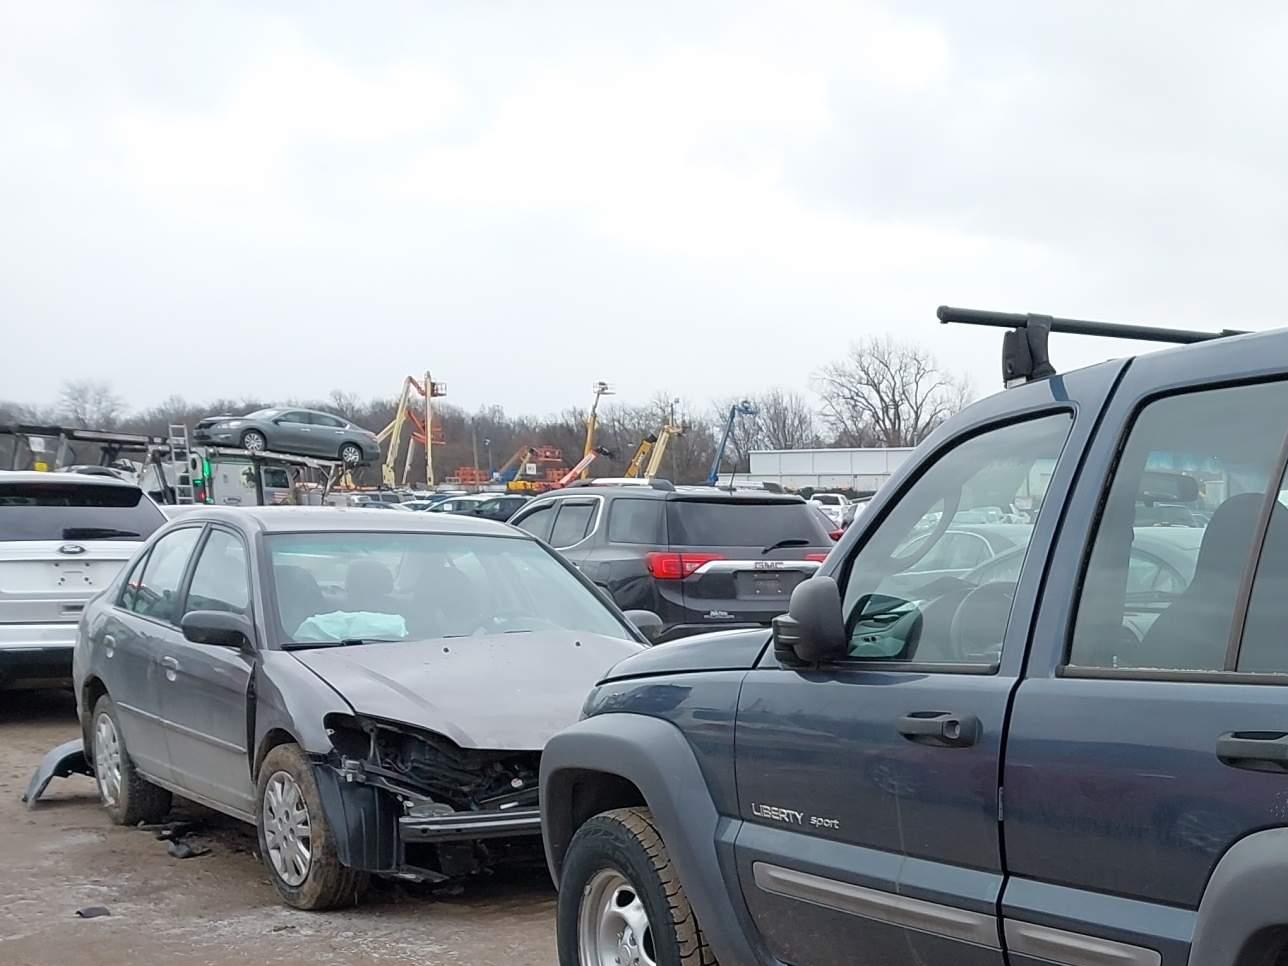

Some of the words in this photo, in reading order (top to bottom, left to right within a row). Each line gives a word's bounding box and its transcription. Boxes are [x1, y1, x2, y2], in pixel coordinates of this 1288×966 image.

[754, 561, 784, 569] GMC
[751, 802, 804, 825] LIBERTY
[809, 815, 840, 829] sport
